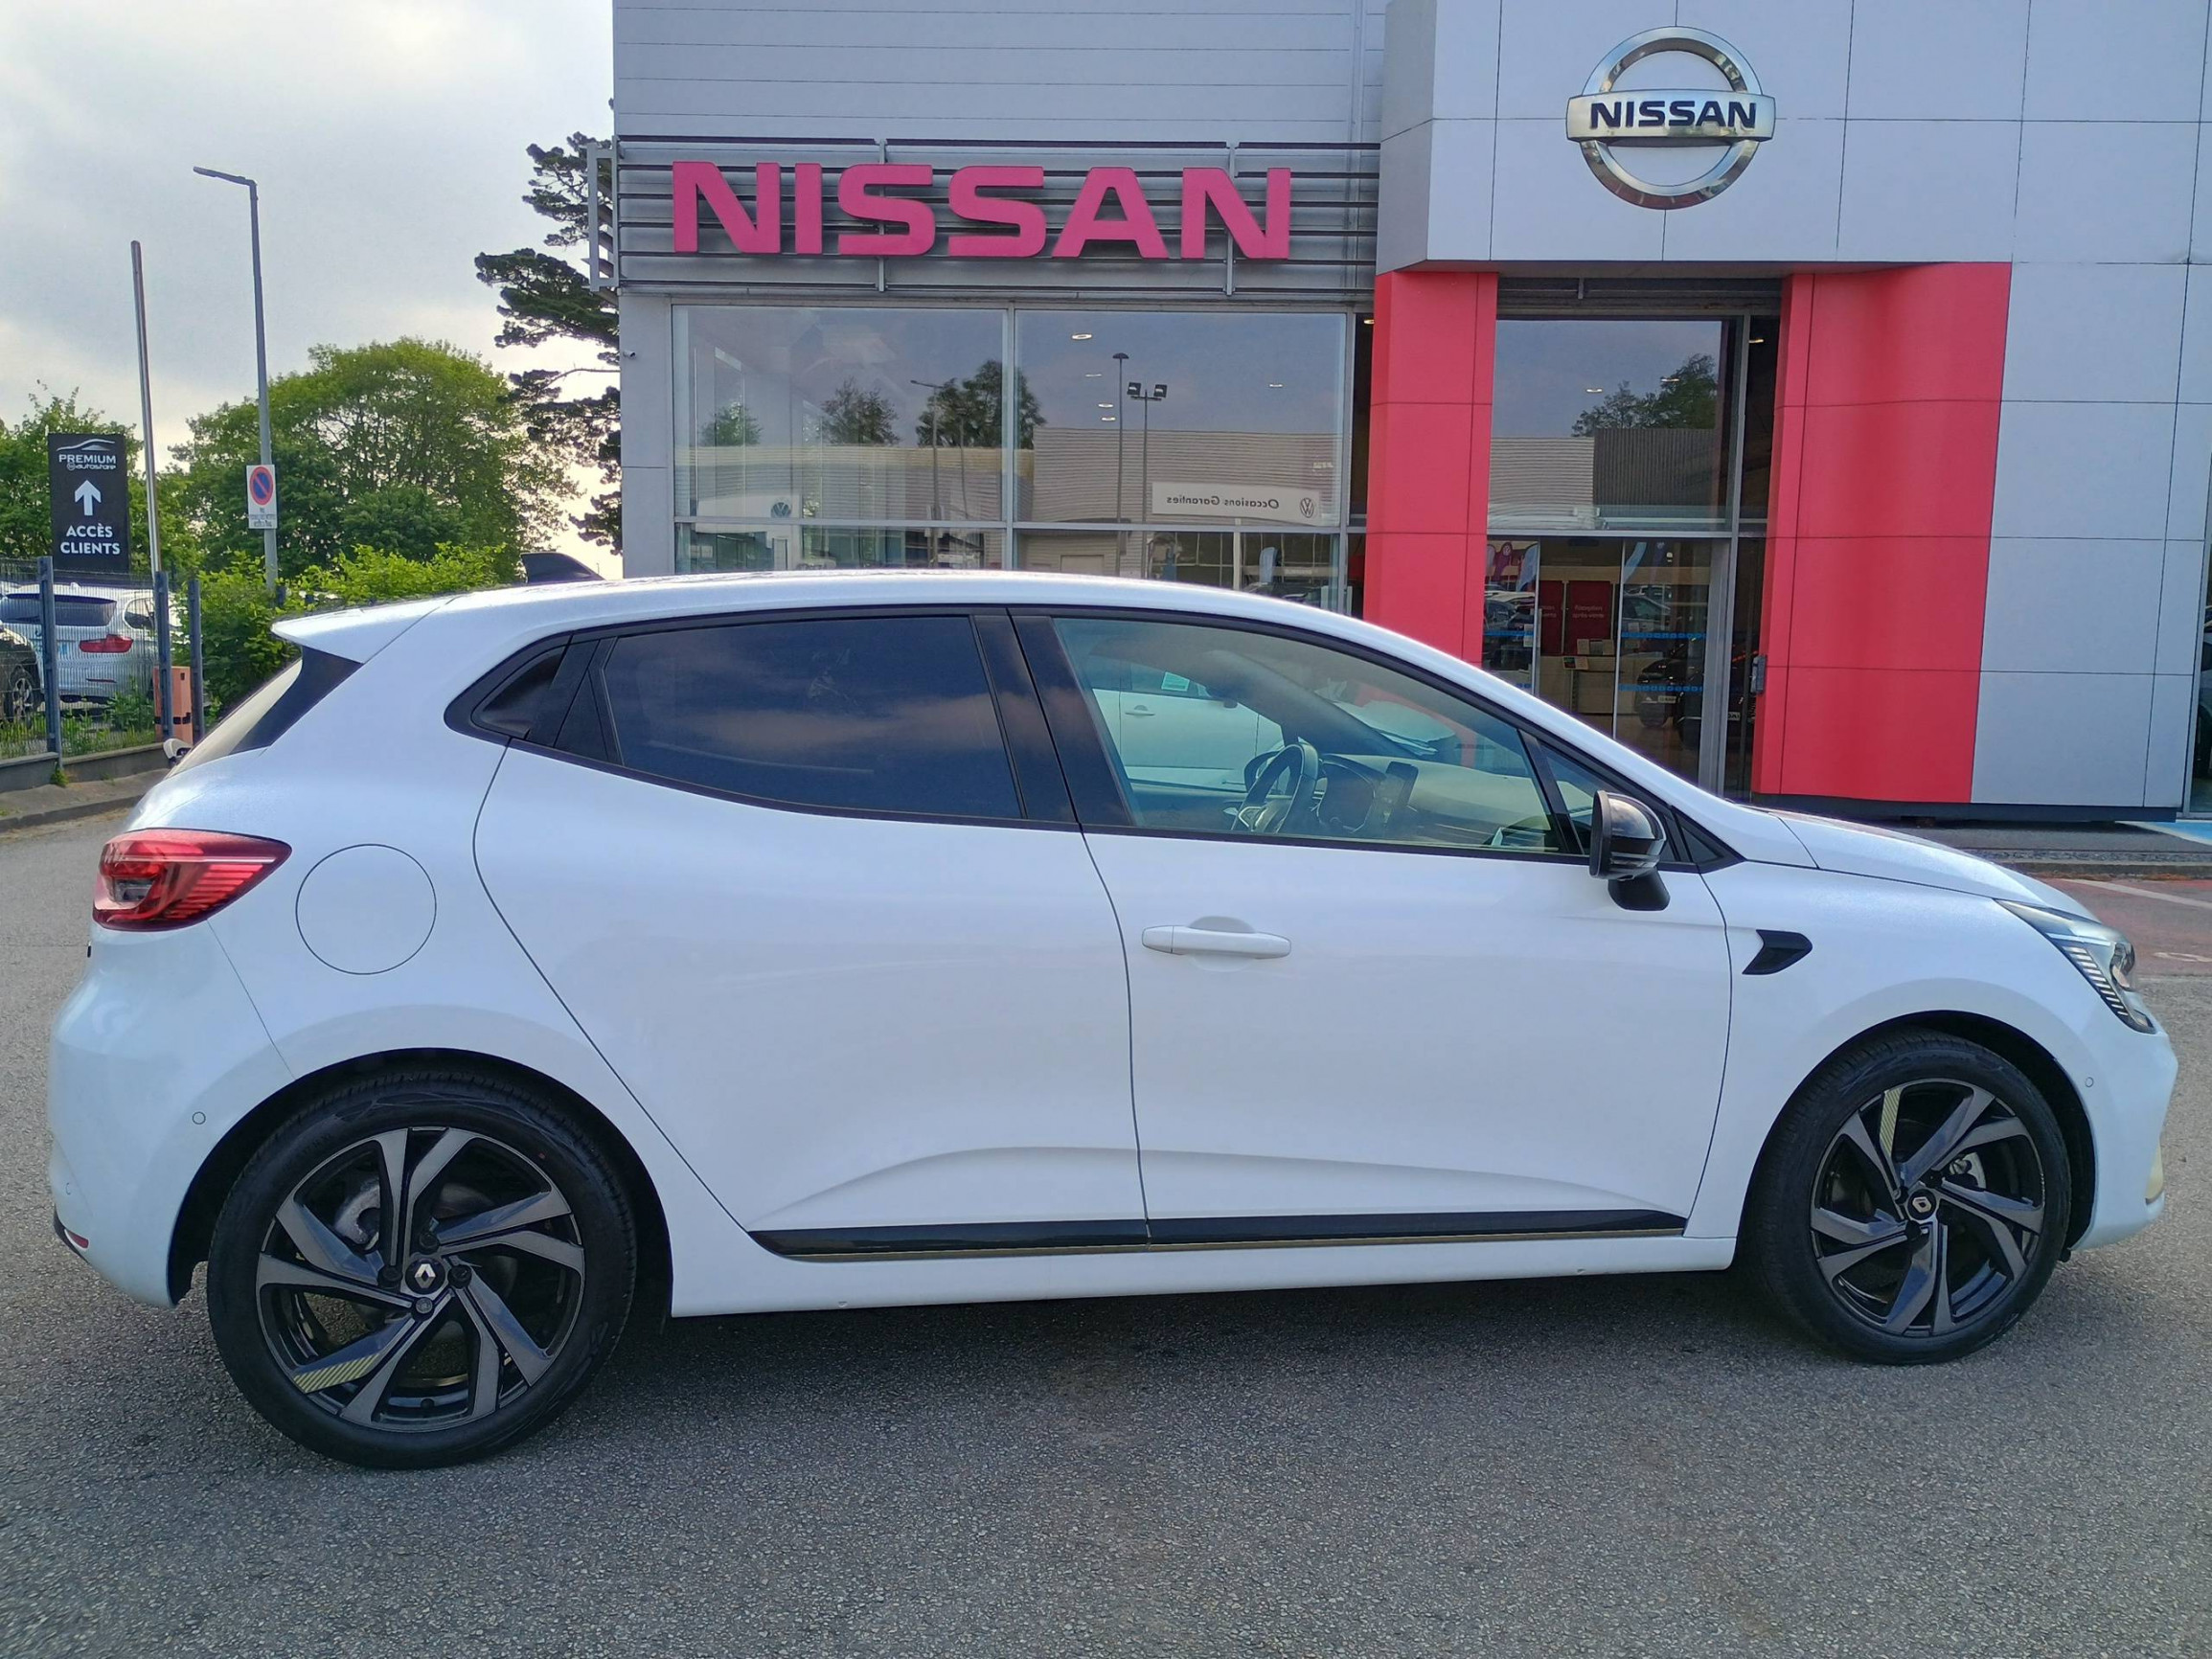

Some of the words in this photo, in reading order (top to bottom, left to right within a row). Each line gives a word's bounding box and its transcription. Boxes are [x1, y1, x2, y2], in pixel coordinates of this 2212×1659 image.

[1590, 101, 1756, 129] NISSAN
[672, 160, 1291, 260] NISSAN
[58, 454, 117, 465] PREMIUM
[66, 523, 113, 537] ACCÈS
[60, 542, 121, 555] CLIENTS
